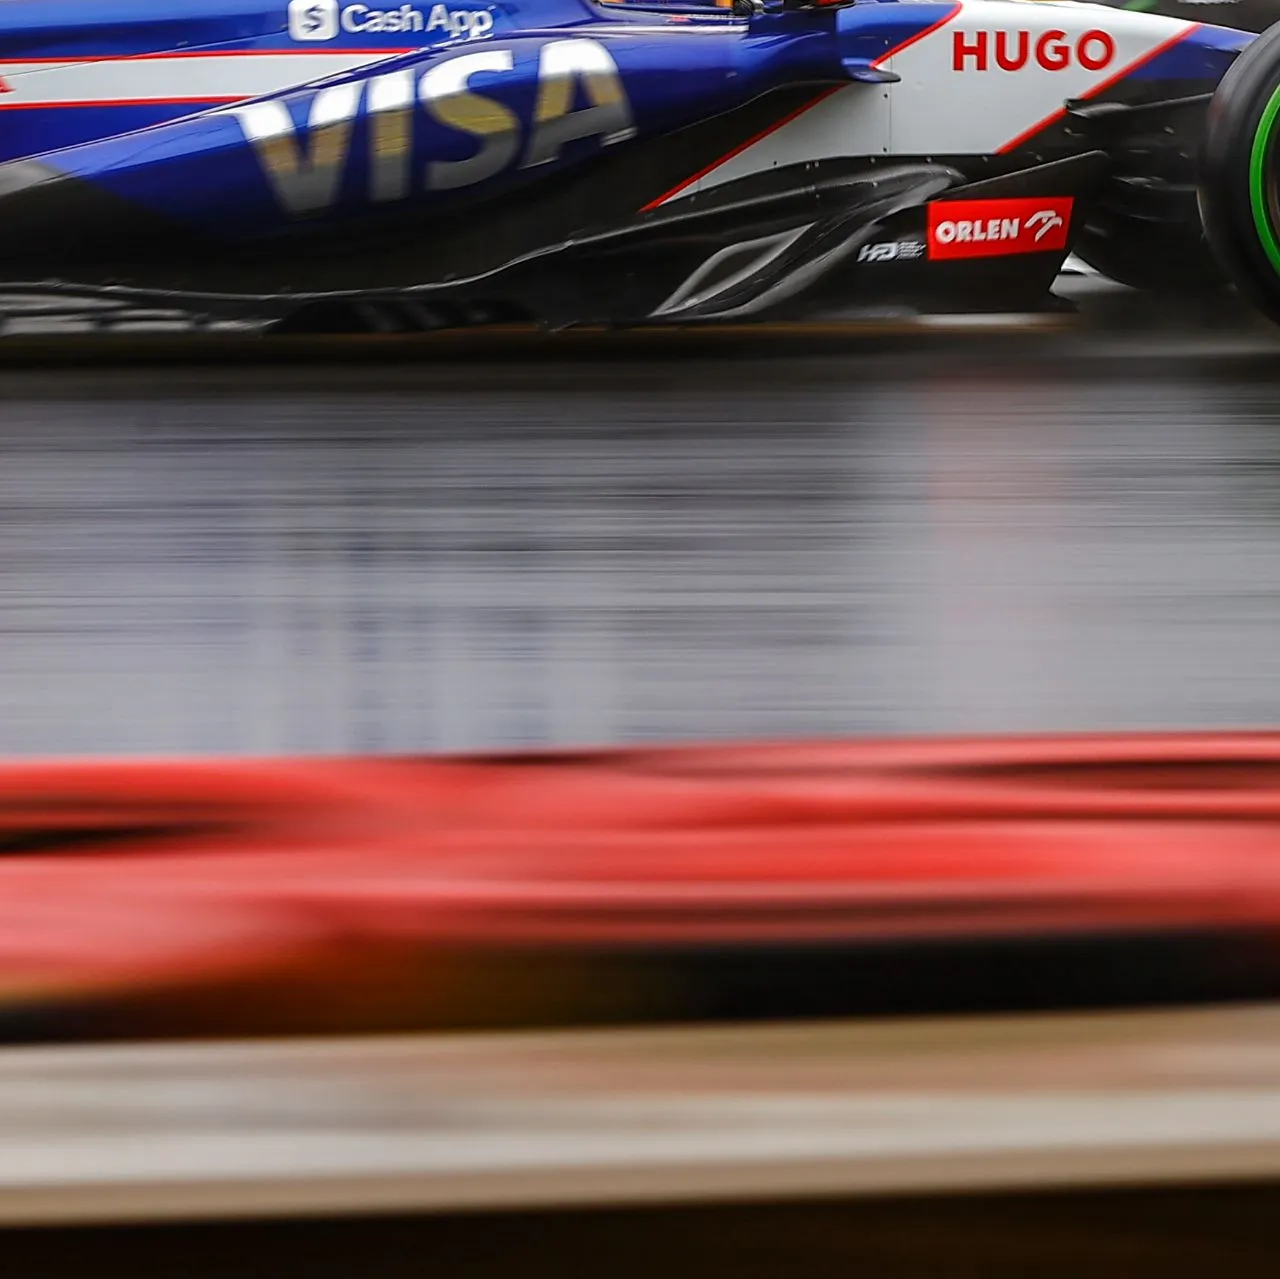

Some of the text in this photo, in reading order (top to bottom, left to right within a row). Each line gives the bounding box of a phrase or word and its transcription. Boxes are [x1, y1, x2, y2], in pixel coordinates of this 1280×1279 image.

[341, 4, 423, 34] Cash
[425, 3, 494, 39] App
[952, 28, 1117, 72] HUGO
[240, 38, 638, 213] VISA
[935, 218, 1020, 244] ORLEN
